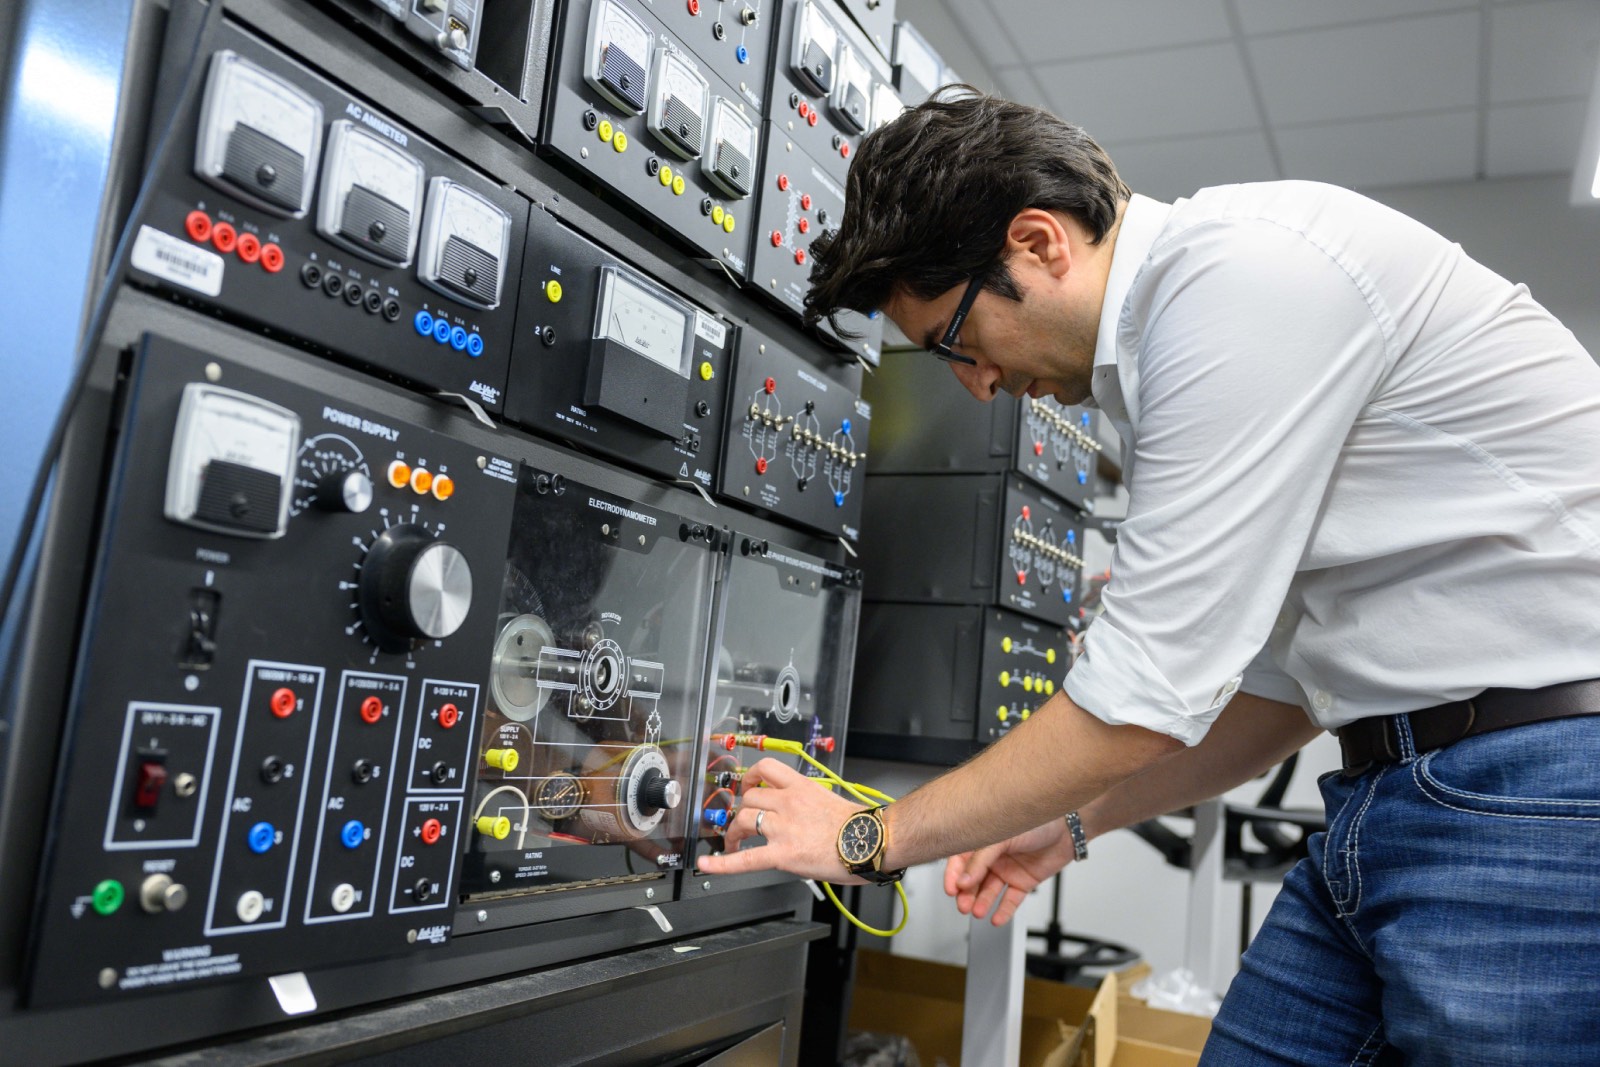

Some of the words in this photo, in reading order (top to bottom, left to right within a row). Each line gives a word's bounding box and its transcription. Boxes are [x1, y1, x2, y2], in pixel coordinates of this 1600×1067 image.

[660, 33, 669, 45] AC
[345, 103, 362, 120] AC
[361, 112, 408, 147] AMMETER
[550, 264, 561, 275] LINE
[542, 281, 546, 289] 1
[534, 326, 541, 335] 2
[702, 349, 713, 359] LOAD
[322, 406, 362, 430] POWER
[361, 419, 400, 442] SUPPLY
[491, 457, 513, 469] CAUTION
[588, 497, 657, 526] ELECTRODYNAMOMETER
[382, 705, 389, 716] 4
[457, 711, 464, 721] 7
[418, 738, 432, 750] DC
[284, 764, 294, 777] 2
[372, 766, 380, 777] 5
[447, 768, 456, 778] N
[232, 797, 253, 812] AC
[328, 797, 344, 810] AC
[142, 859, 177, 873] RESET
[401, 856, 415, 868] DC
[431, 883, 439, 894] N
[162, 945, 211, 962] WARNING
